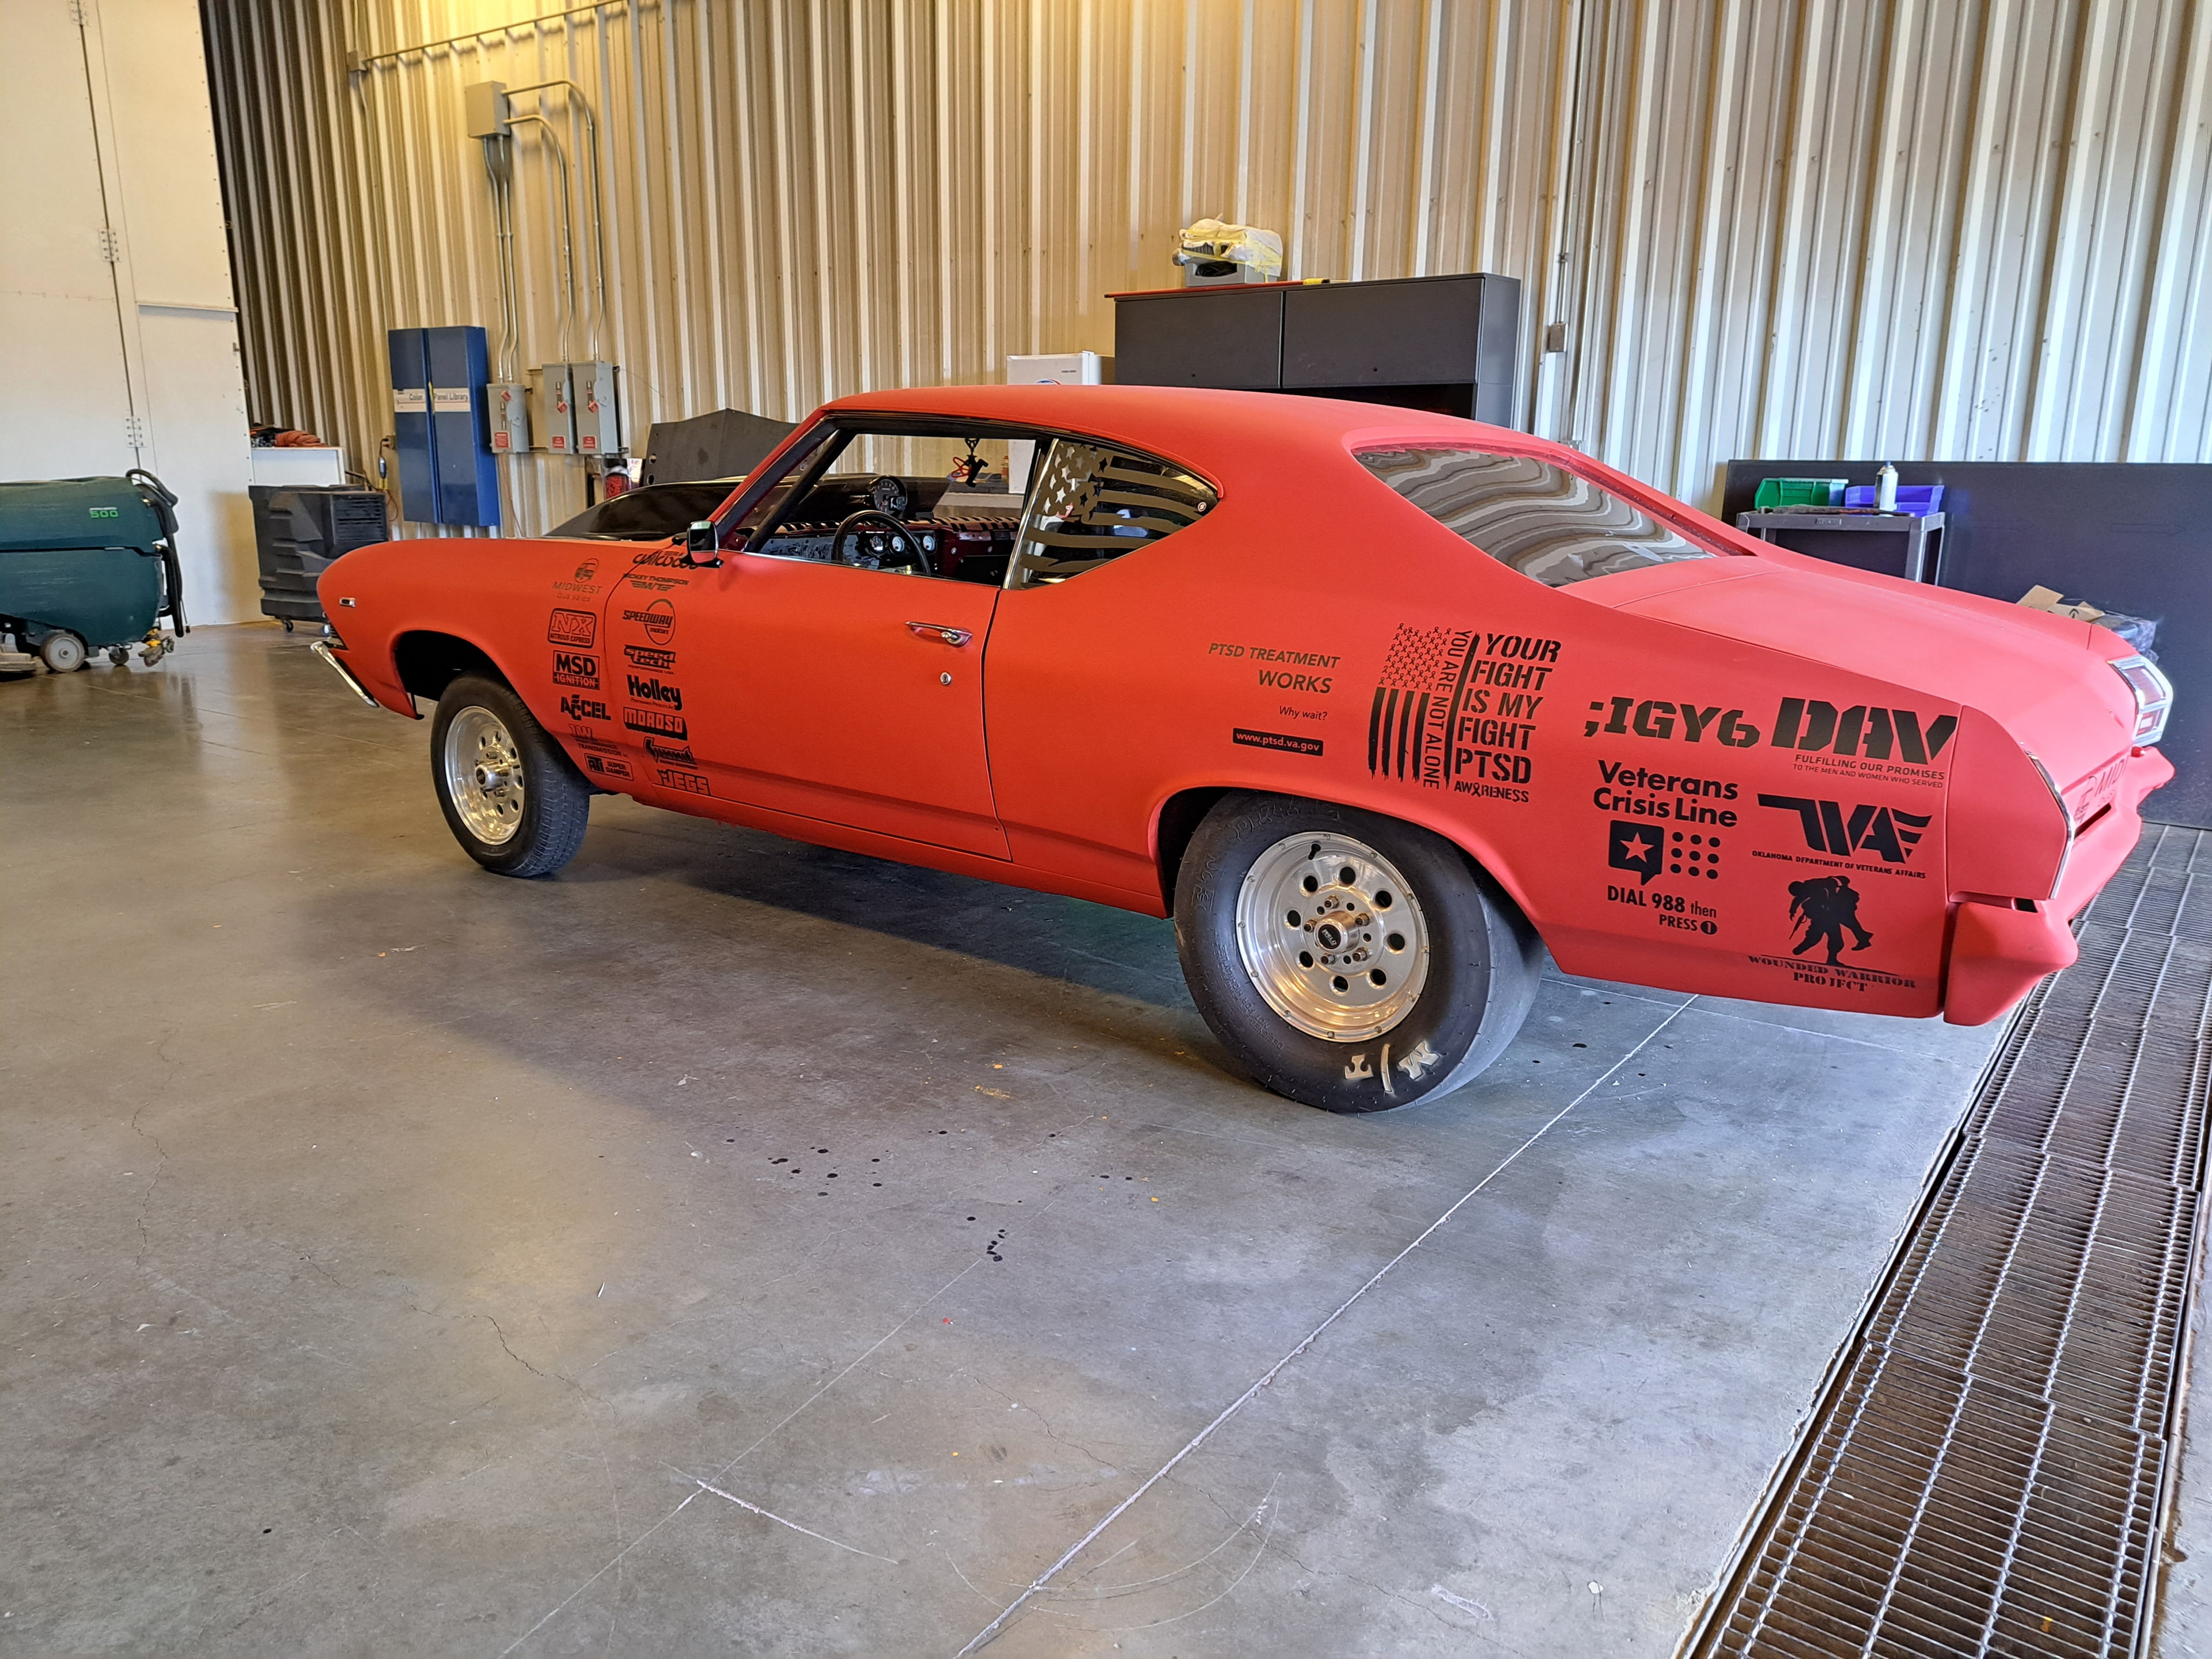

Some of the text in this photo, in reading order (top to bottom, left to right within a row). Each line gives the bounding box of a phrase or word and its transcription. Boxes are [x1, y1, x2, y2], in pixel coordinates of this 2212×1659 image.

[449, 393, 468, 402] Library
[90, 510, 119, 518] 500
[552, 581, 603, 594] MIDWEST
[649, 576, 690, 585] THOMPSON
[551, 612, 593, 637] NX
[623, 609, 673, 628] SPEEDWAY
[550, 633, 591, 643] NITROUS EXPRESS
[1486, 632, 1561, 662] YOUR
[556, 653, 596, 676] MSD
[1209, 643, 1340, 668] PTSD TREATMENT
[556, 674, 596, 688] IGNITION
[1259, 669, 1332, 694] WORKS
[1470, 660, 1553, 691] FIGHT
[627, 674, 683, 711] Holley
[1462, 688, 1544, 719] IS MY
[560, 694, 611, 721] ACCEL
[624, 707, 683, 733] MOROSO
[1279, 706, 1328, 721] Why wait?
[1423, 630, 1472, 790] YOU ARE NOT ALONE
[1236, 732, 1320, 751] www.ptsd.va.gov
[1457, 716, 1536, 751] FIGHT
[1771, 696, 1958, 765] DAV
[578, 743, 622, 756] TRANSMISSION
[605, 767, 631, 778] DAMPER
[607, 761, 627, 771] SUPER
[1455, 747, 1532, 784] PTSD
[1796, 754, 1945, 780] FULFILLING OUR PROMISES
[1821, 767, 1838, 775] MEN
[1839, 769, 1856, 777] AND
[1858, 772, 1889, 782] WOMEN
[1891, 775, 1910, 784] WHO
[1911, 778, 1943, 789] SERVED
[658, 769, 711, 796] JEGS
[1598, 759, 1738, 800] Veterans
[1593, 787, 1738, 827] Crisis Line
[1752, 850, 1793, 862] OKLAHOMA
[1796, 856, 1843, 868] DEPARTMENT
[1855, 864, 1893, 874] VETERANS
[1895, 869, 1926, 879] AFFAIRS
[1607, 885, 1717, 918] DIAL 988 then
[1659, 914, 1698, 931] PRESS
[1321, 929, 1337, 946] WELD
[1748, 955, 1916, 988] WOUNDED WARRIOR
[1793, 972, 1868, 992] PROJECT
